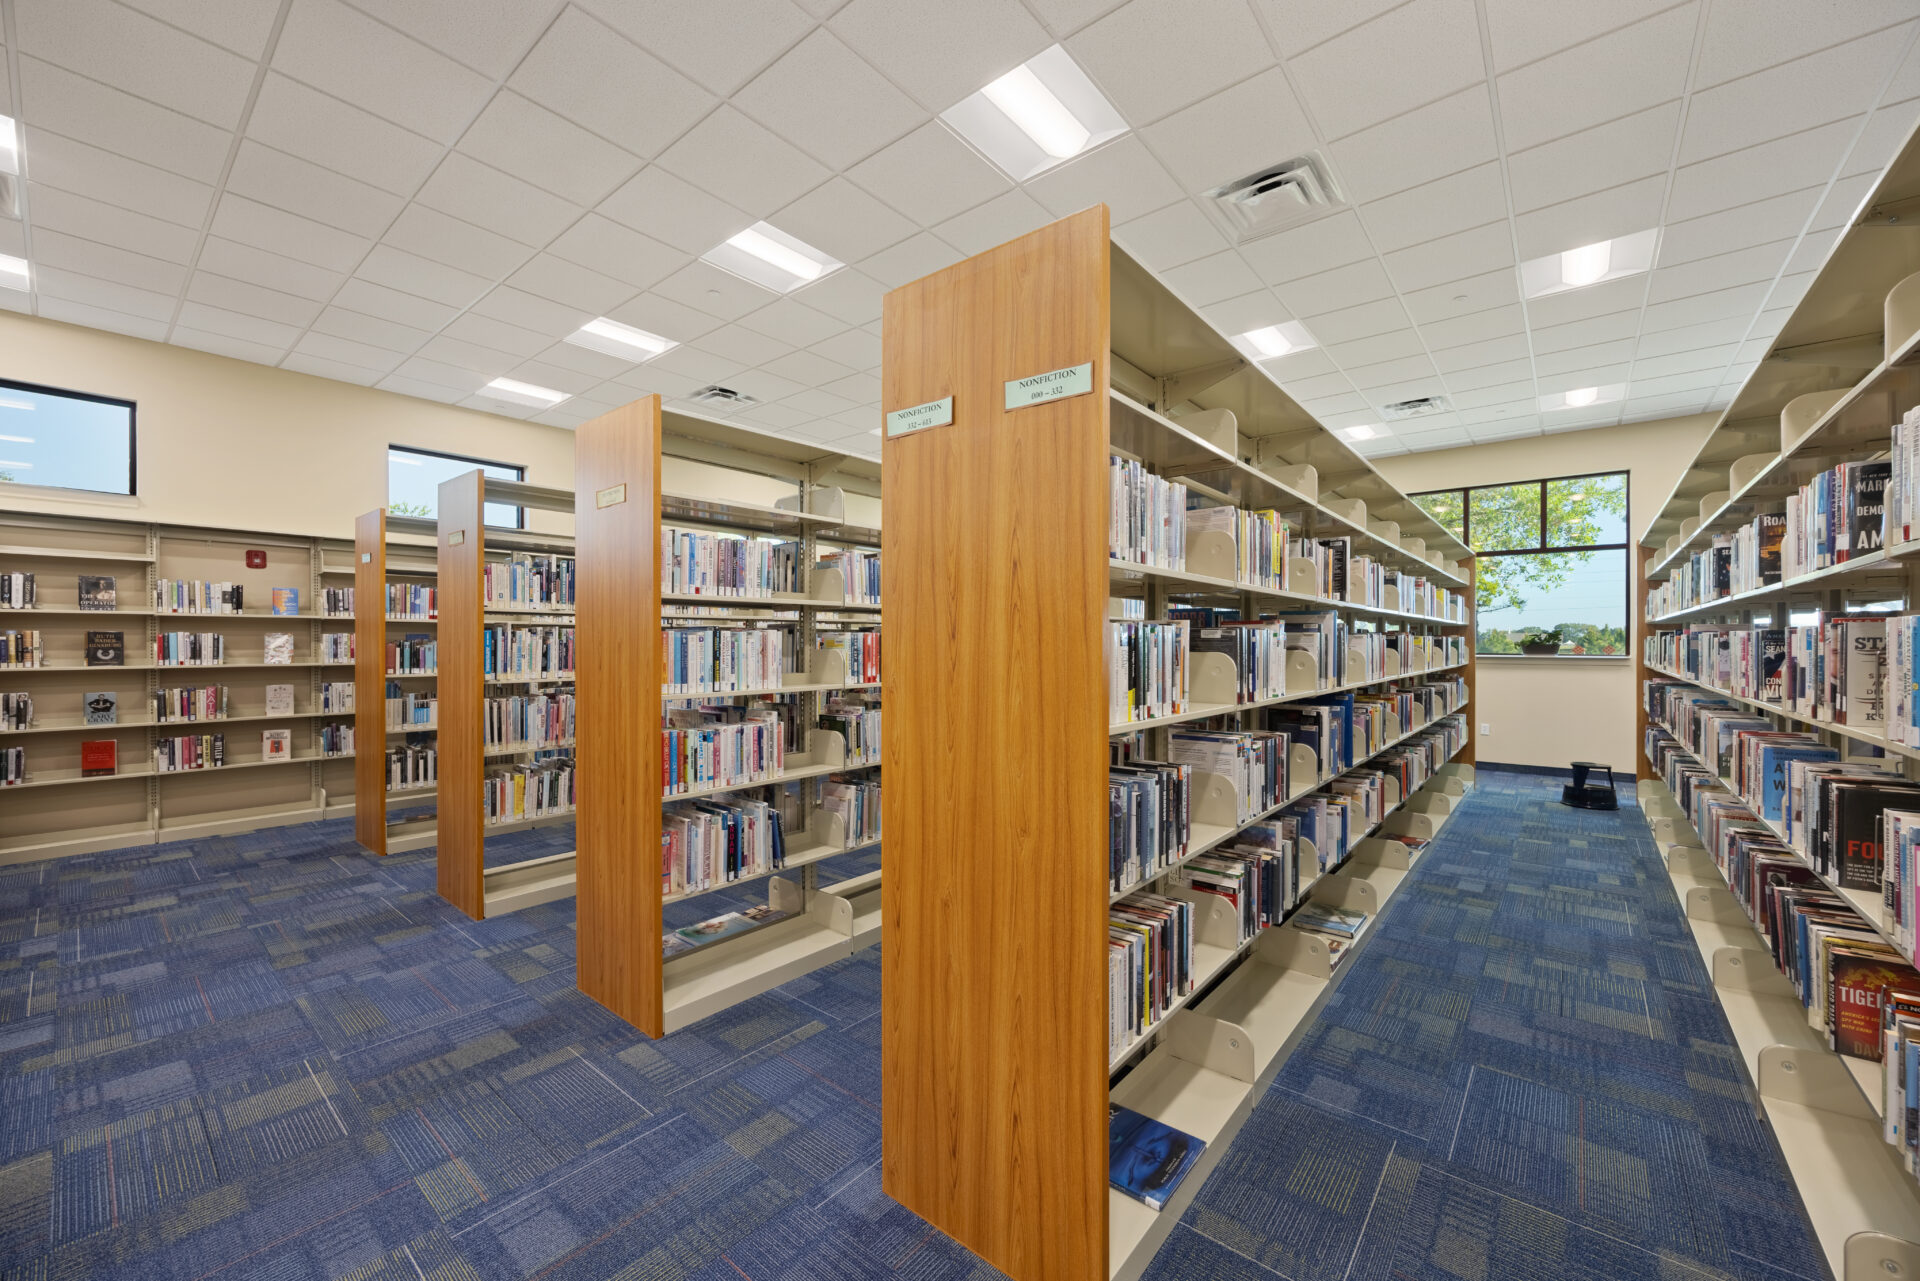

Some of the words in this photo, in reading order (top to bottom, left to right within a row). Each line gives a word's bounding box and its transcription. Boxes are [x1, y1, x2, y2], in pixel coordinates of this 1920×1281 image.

[1019, 369, 1077, 389] NONFICTION
[1031, 391, 1044, 400] 000
[1050, 386, 1063, 396] 332
[897, 403, 942, 420] NONFICTION
[907, 421, 917, 430] 332
[207, 688, 216, 716] KATE
